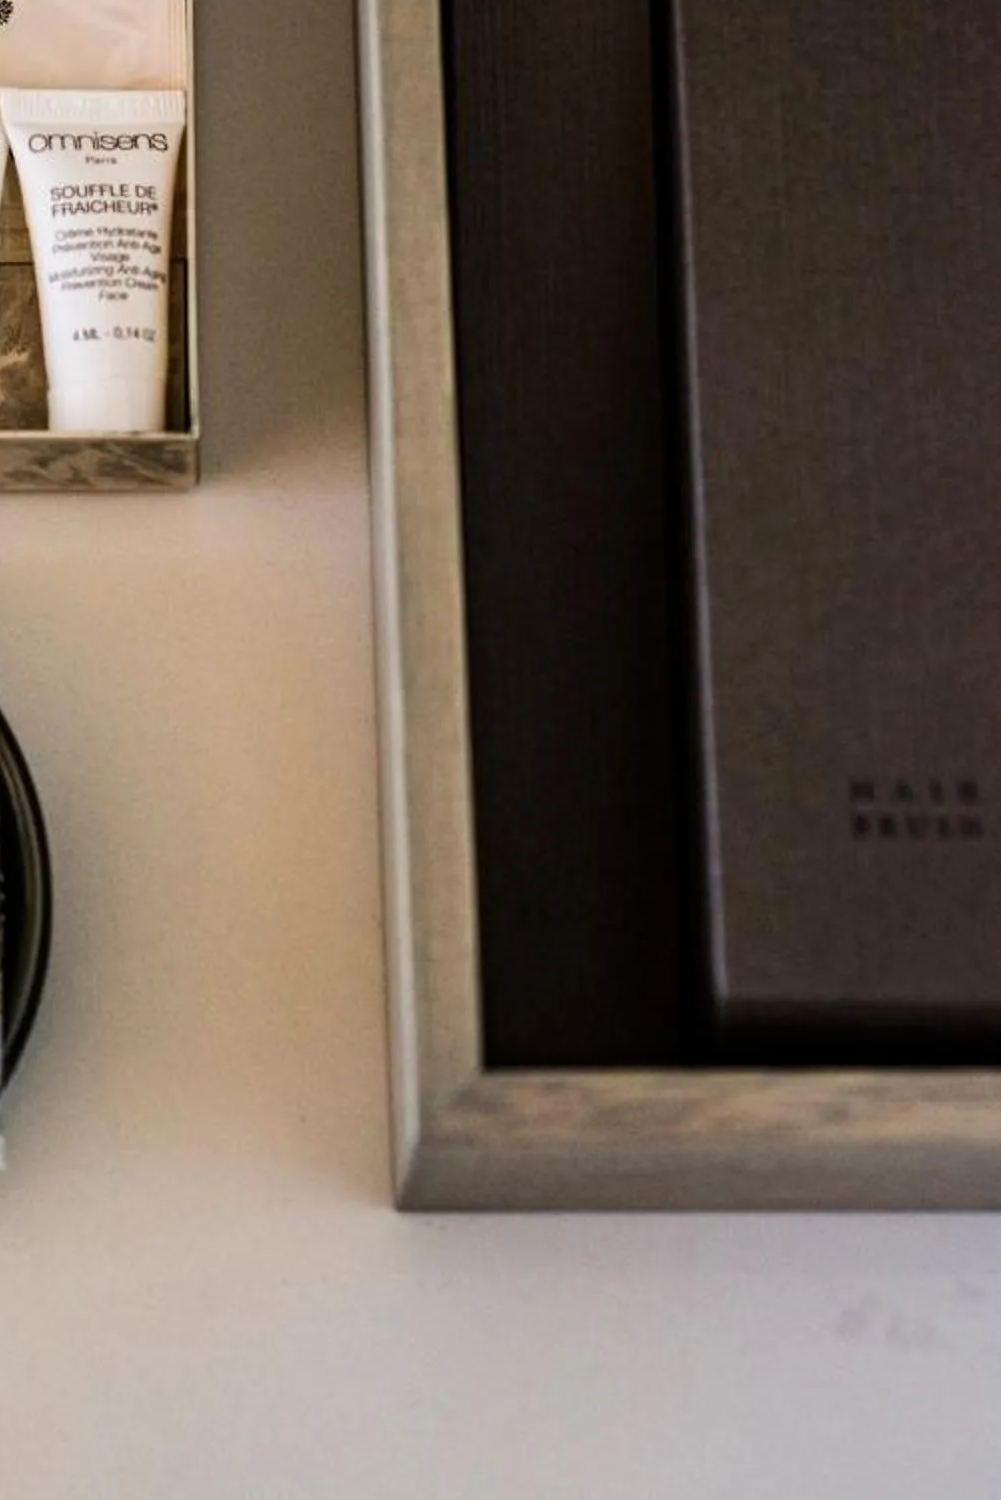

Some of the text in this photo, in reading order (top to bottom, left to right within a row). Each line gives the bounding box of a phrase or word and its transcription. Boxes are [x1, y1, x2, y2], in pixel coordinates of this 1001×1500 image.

[28, 131, 168, 153] omnisens
[85, 156, 117, 165] Paris
[50, 183, 157, 200] SOUFFLE DE
[97, 290, 129, 302] Face
